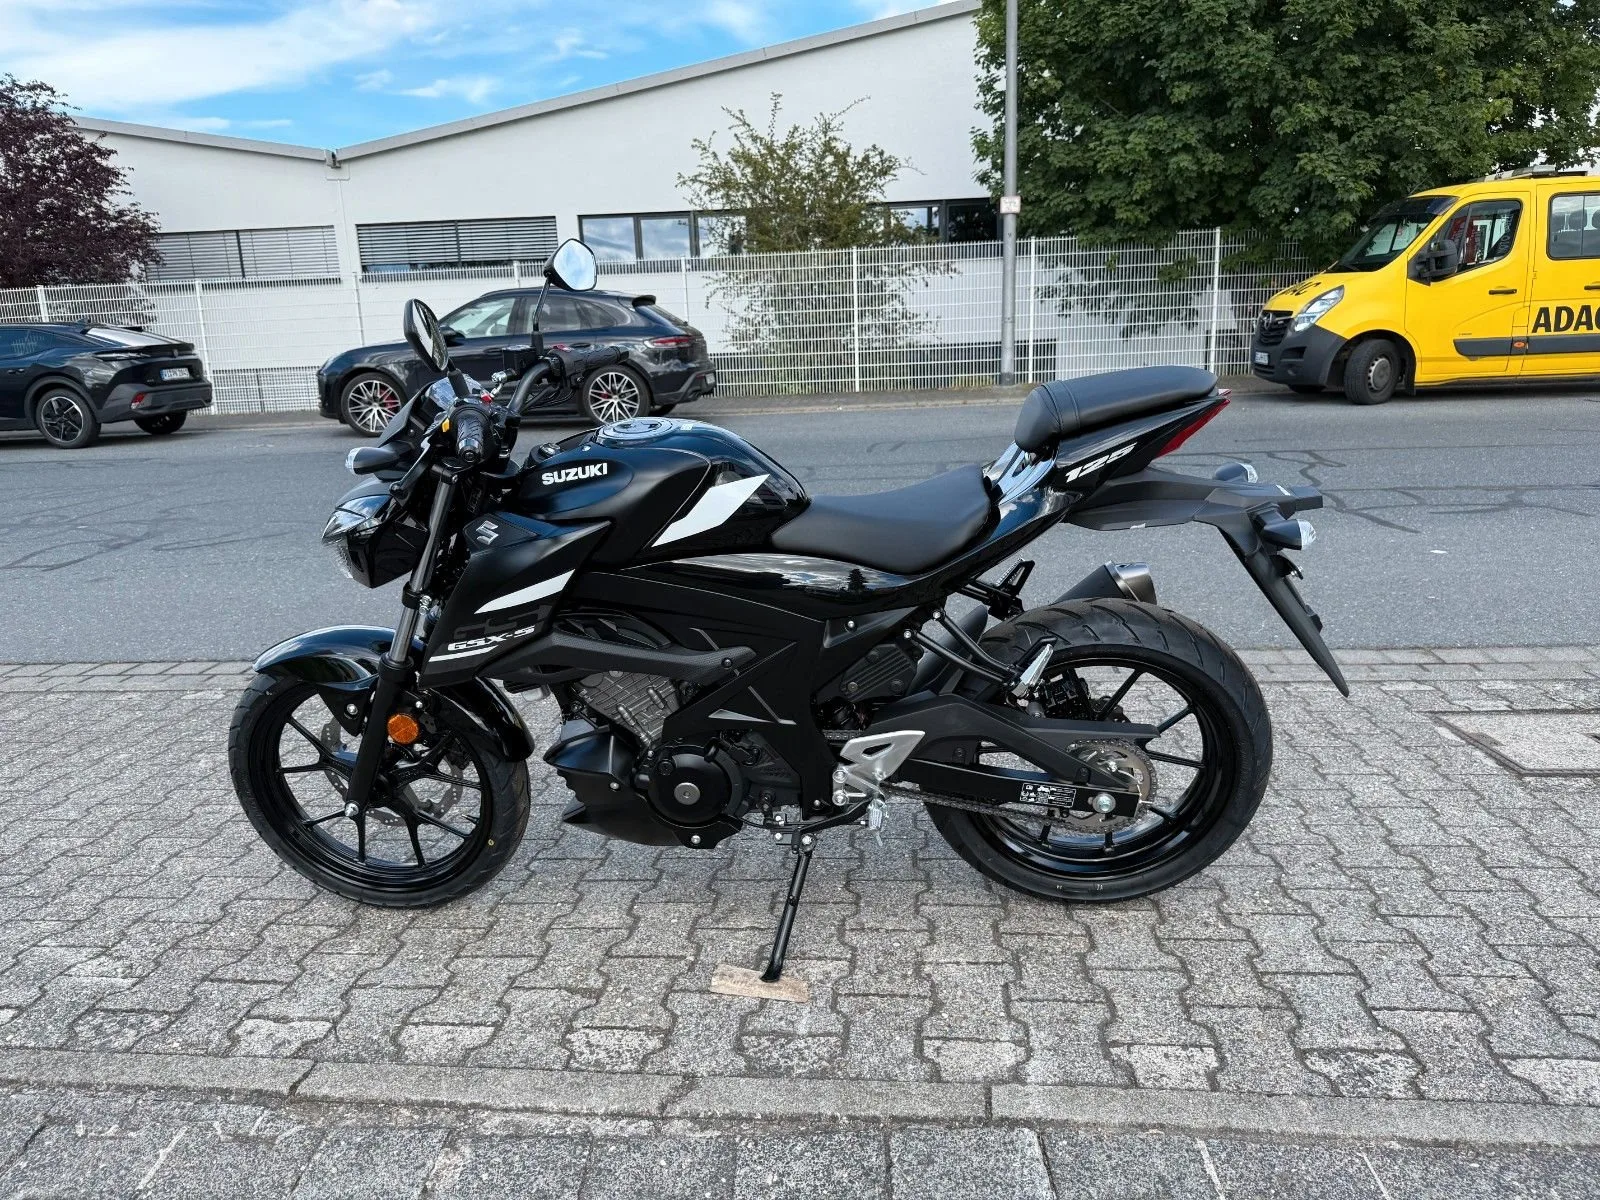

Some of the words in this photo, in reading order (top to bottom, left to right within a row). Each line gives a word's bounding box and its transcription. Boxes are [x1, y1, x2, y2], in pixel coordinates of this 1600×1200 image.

[1531, 304, 1600, 333] ADA
[541, 462, 608, 486] SUZUKI
[1065, 441, 1138, 483] 125
[447, 624, 536, 651] GSX-S
